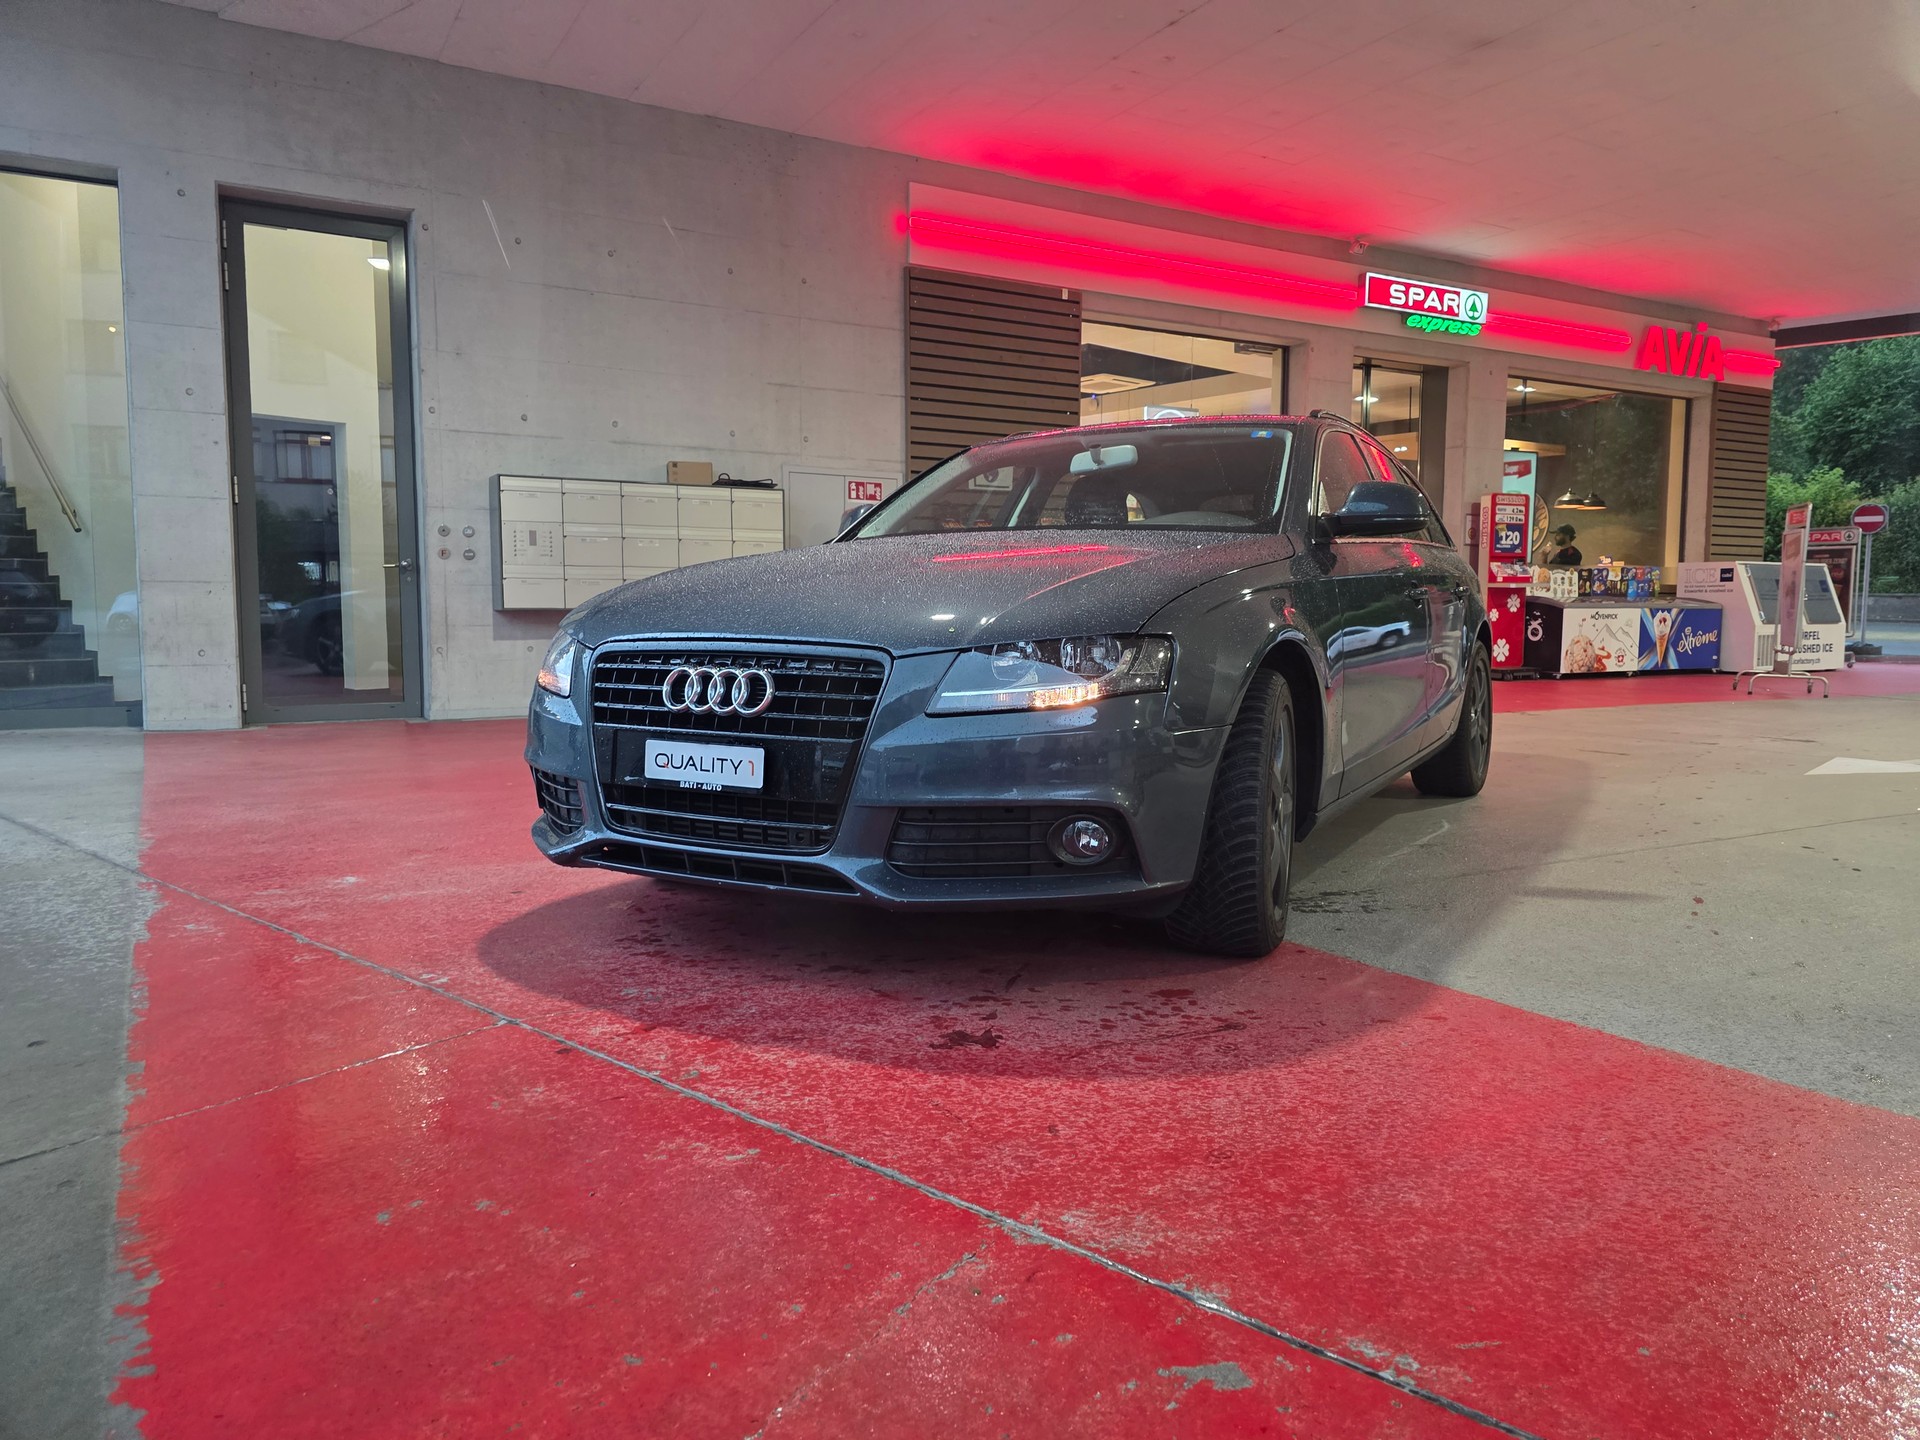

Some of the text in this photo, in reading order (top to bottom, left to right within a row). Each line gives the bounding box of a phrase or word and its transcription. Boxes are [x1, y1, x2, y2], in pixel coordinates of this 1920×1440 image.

[1389, 283, 1460, 314] SPAR
[1406, 312, 1482, 337] express
[1496, 495, 1525, 504] SWISSLOS
[1481, 506, 1489, 549] SWISSLOS
[1500, 530, 1521, 545] 120
[1809, 533, 1841, 542] PAR
[1684, 568, 1718, 584] ICE
[1822, 643, 1834, 653] ICE
